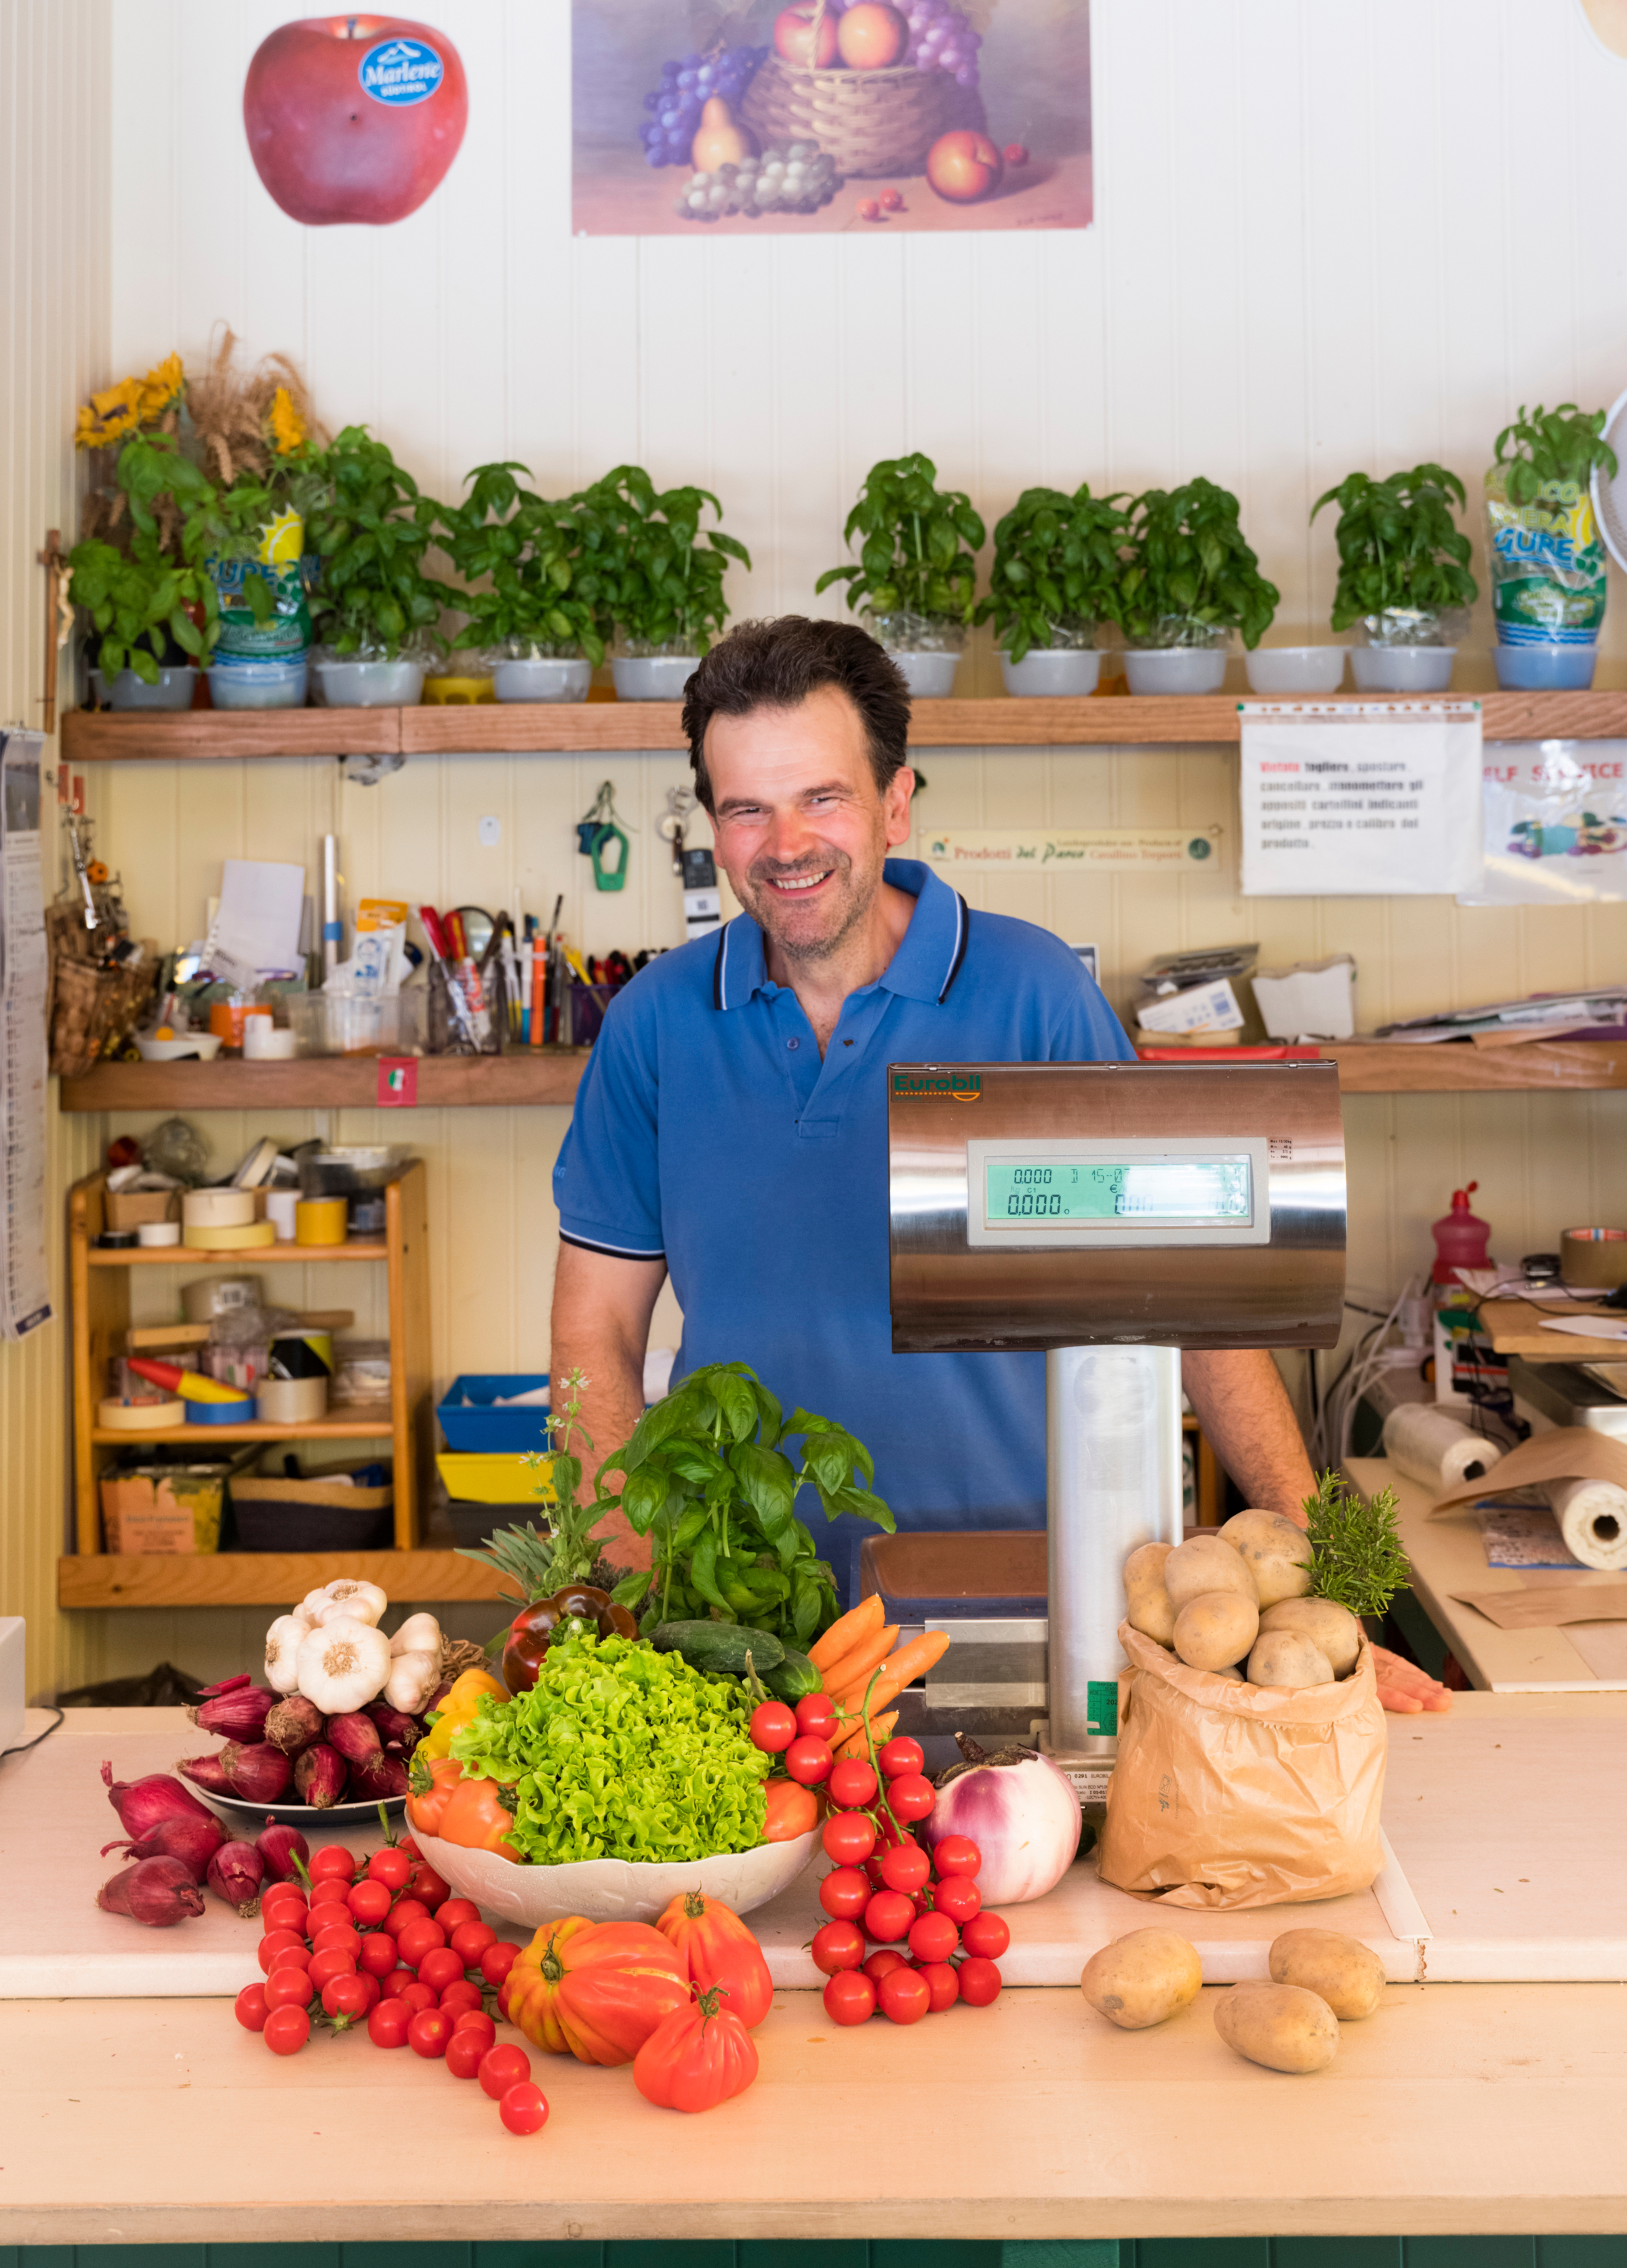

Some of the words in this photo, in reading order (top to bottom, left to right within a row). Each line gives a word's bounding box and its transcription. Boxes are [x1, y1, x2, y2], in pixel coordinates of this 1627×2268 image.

[365, 60, 441, 87] Marlene
[954, 846, 1011, 860] Prodotti
[894, 1075, 980, 1091] Eurobil
